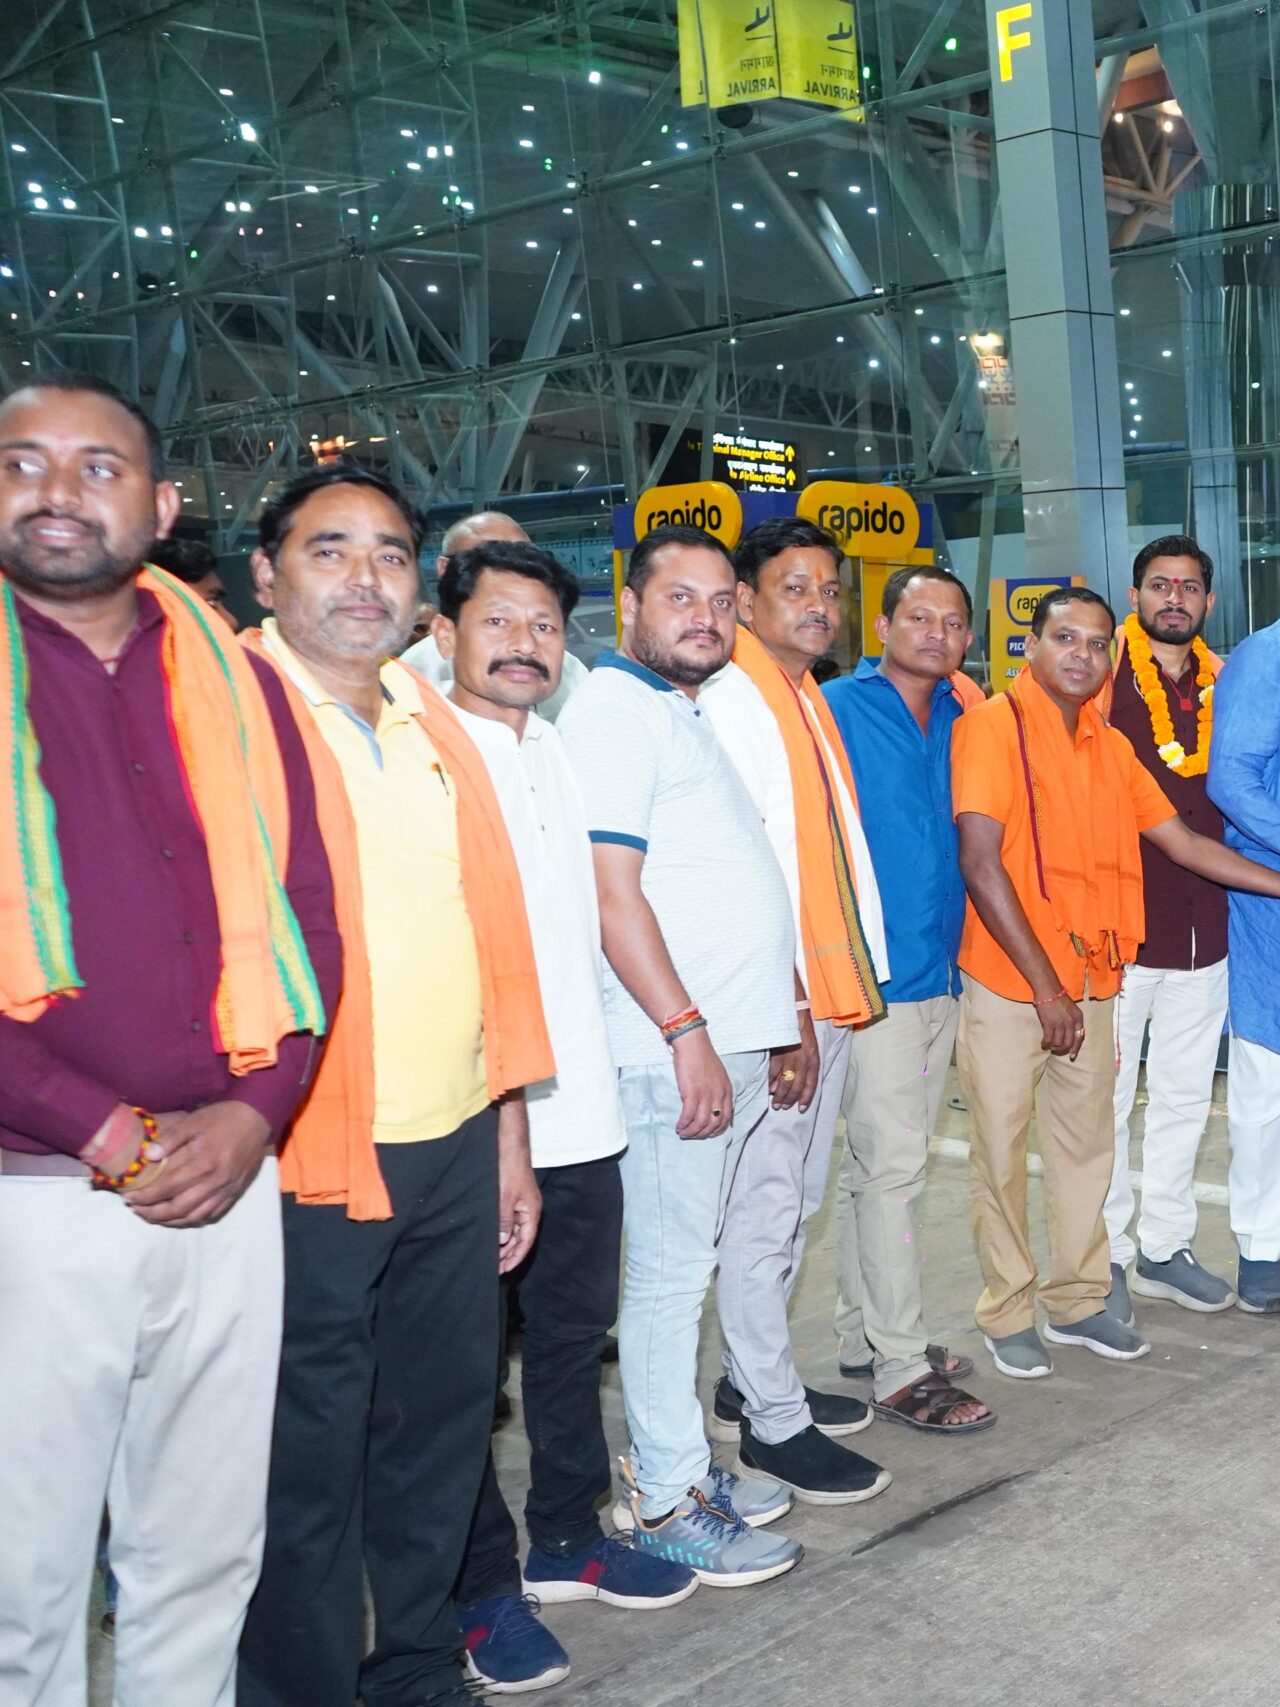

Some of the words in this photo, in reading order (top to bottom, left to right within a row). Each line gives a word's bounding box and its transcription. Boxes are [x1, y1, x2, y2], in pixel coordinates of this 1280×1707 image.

[996, 2, 1032, 82] F
[731, 446, 763, 461] Manager
[763, 450, 786, 462] Office
[764, 473, 786, 485] Office
[818, 500, 905, 540] rapido
